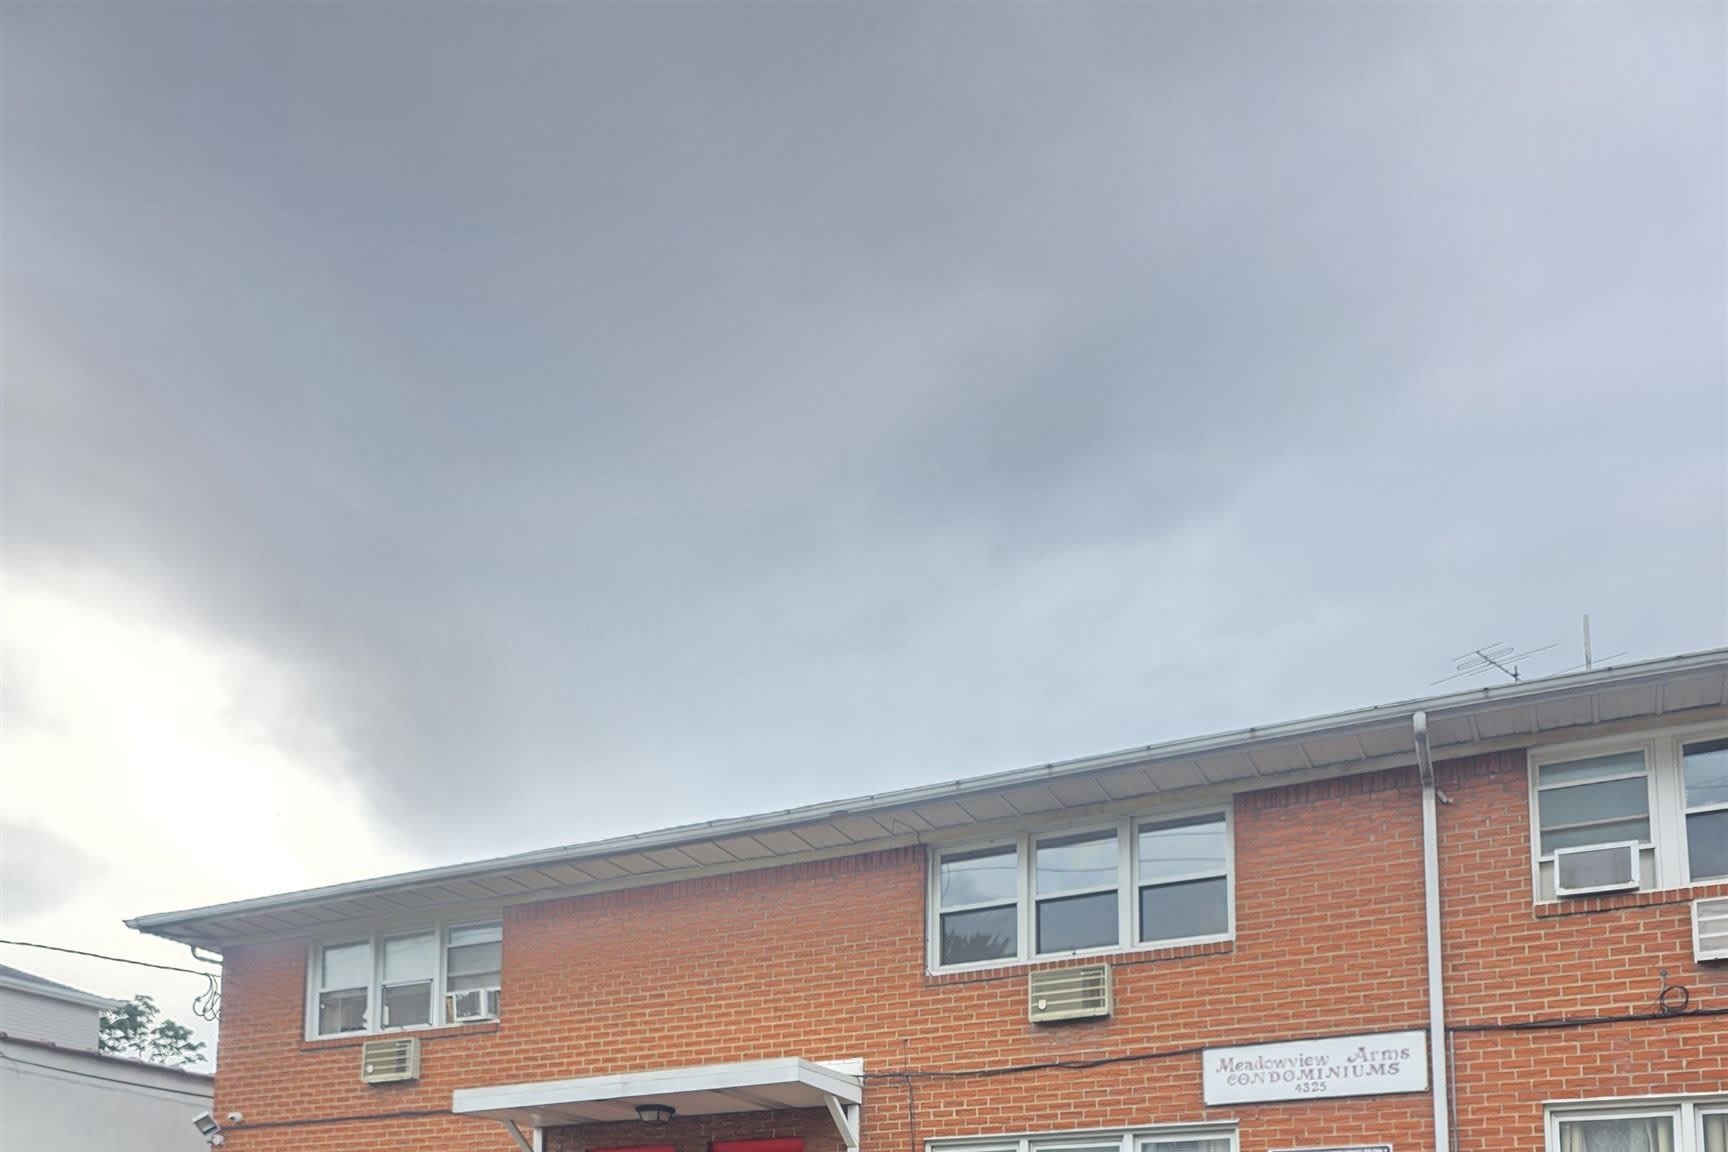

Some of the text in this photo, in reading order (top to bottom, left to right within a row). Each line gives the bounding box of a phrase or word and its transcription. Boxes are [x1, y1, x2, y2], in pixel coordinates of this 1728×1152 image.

[1216, 1046, 1409, 1073] Meadowview Arms
[1226, 1061, 1400, 1086] CONDOMINIUMS
[1294, 1081, 1327, 1094] 4325
